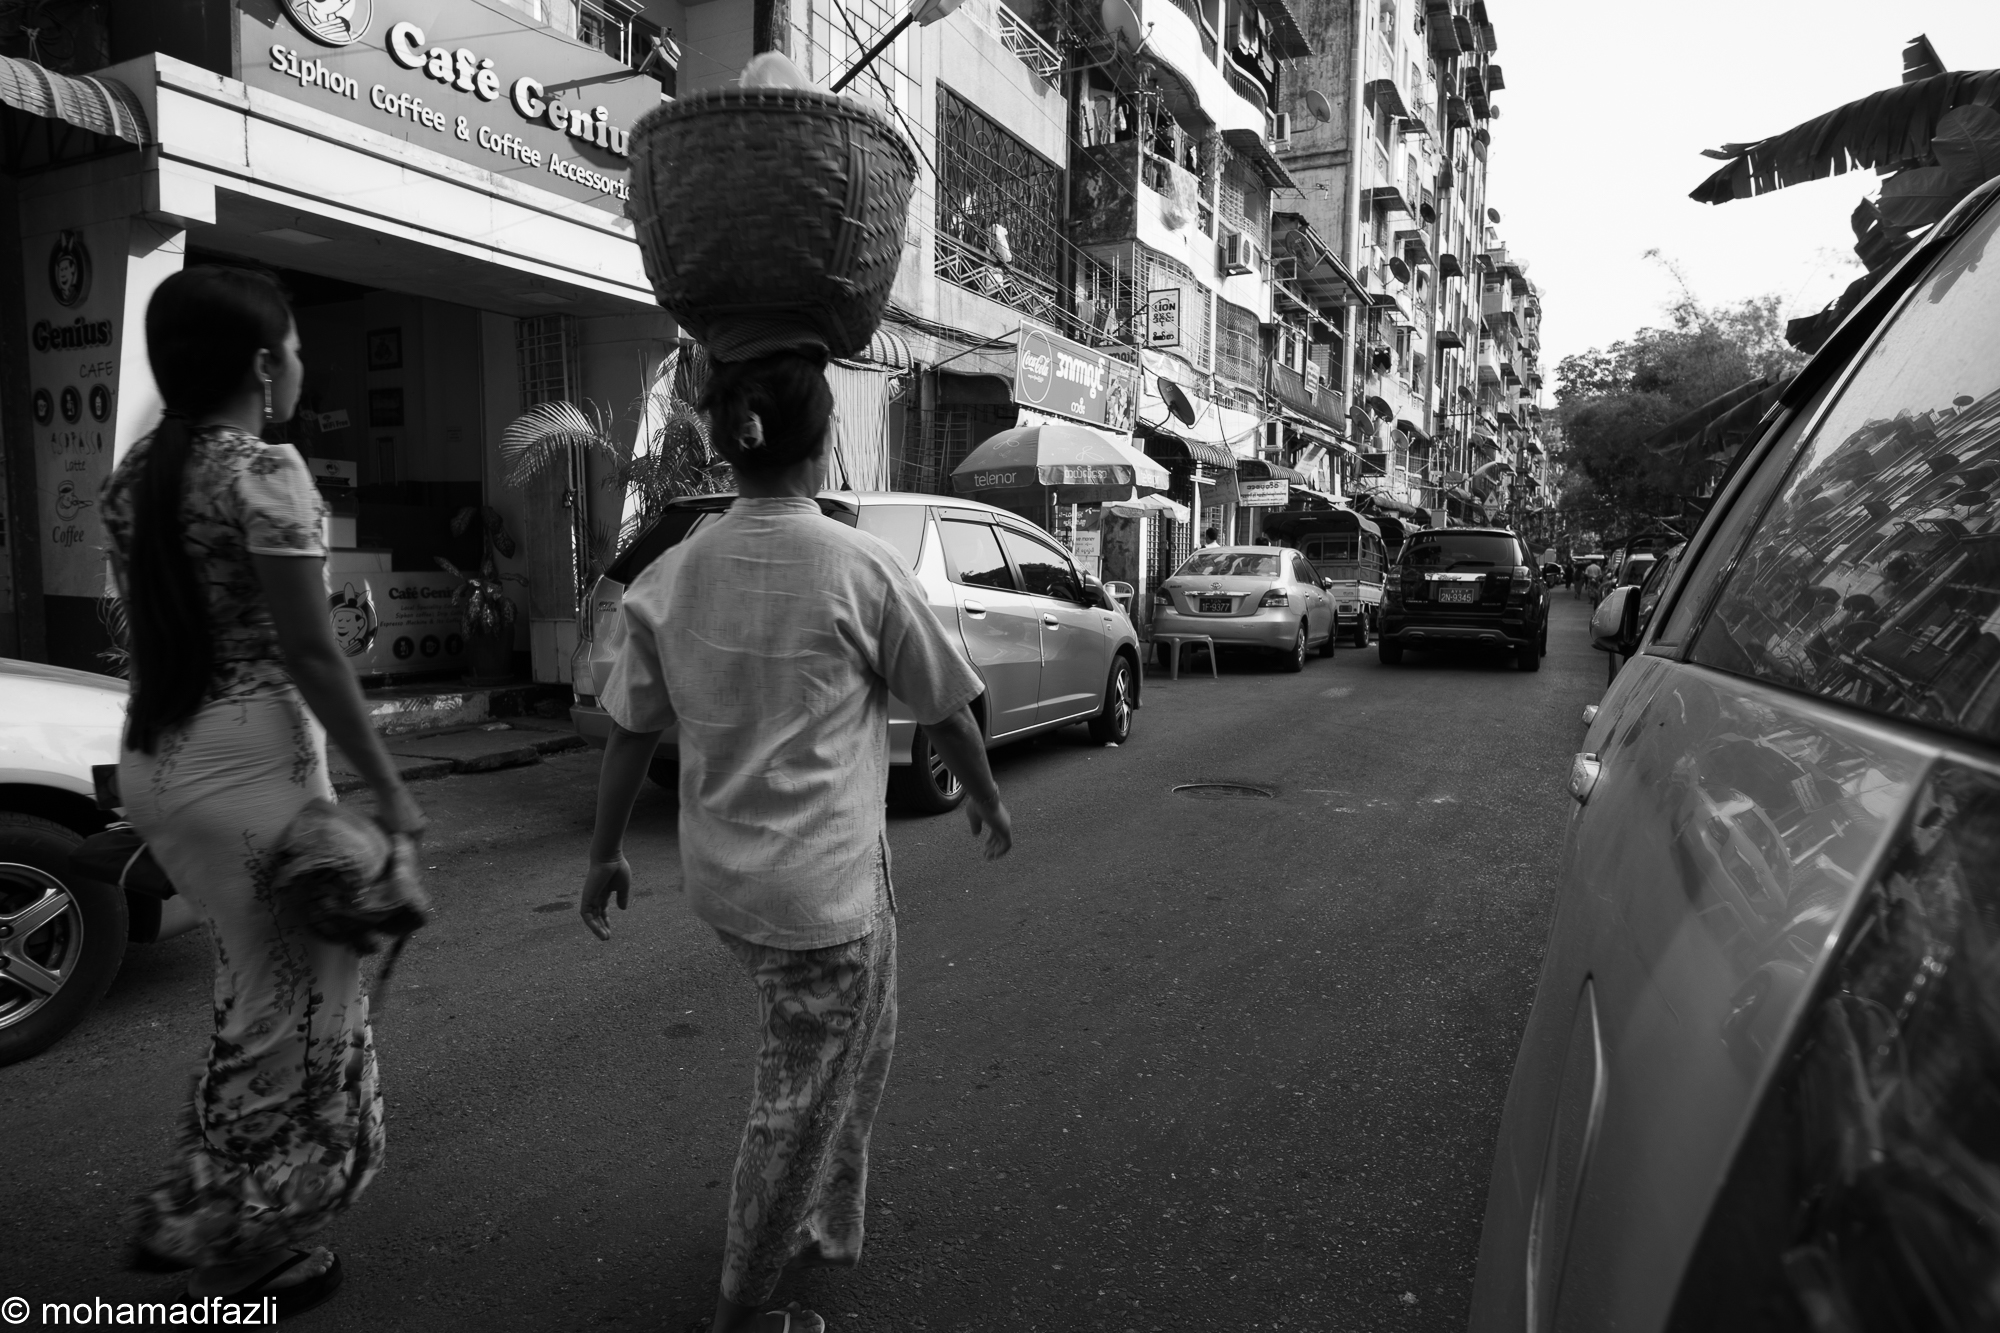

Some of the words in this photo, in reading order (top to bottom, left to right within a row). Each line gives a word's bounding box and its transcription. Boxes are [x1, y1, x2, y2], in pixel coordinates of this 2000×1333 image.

[386, 21, 500, 101] Café
[511, 76, 630, 158] Geniu
[270, 44, 358, 99] Siphon
[371, 84, 446, 131] Coffee
[456, 115, 470, 141] &
[478, 125, 541, 167] Coffee
[33, 317, 110, 351] Genius
[80, 361, 113, 378] CAFE
[65, 460, 86, 472] Latte
[974, 471, 1017, 487] telenor
[52, 525, 85, 547] Coffee
[388, 587, 418, 599] Café
[1441, 593, 1472, 603] 2N-9345
[1202, 603, 1230, 612] 1F-9377
[380, 620, 403, 628] Espresso
